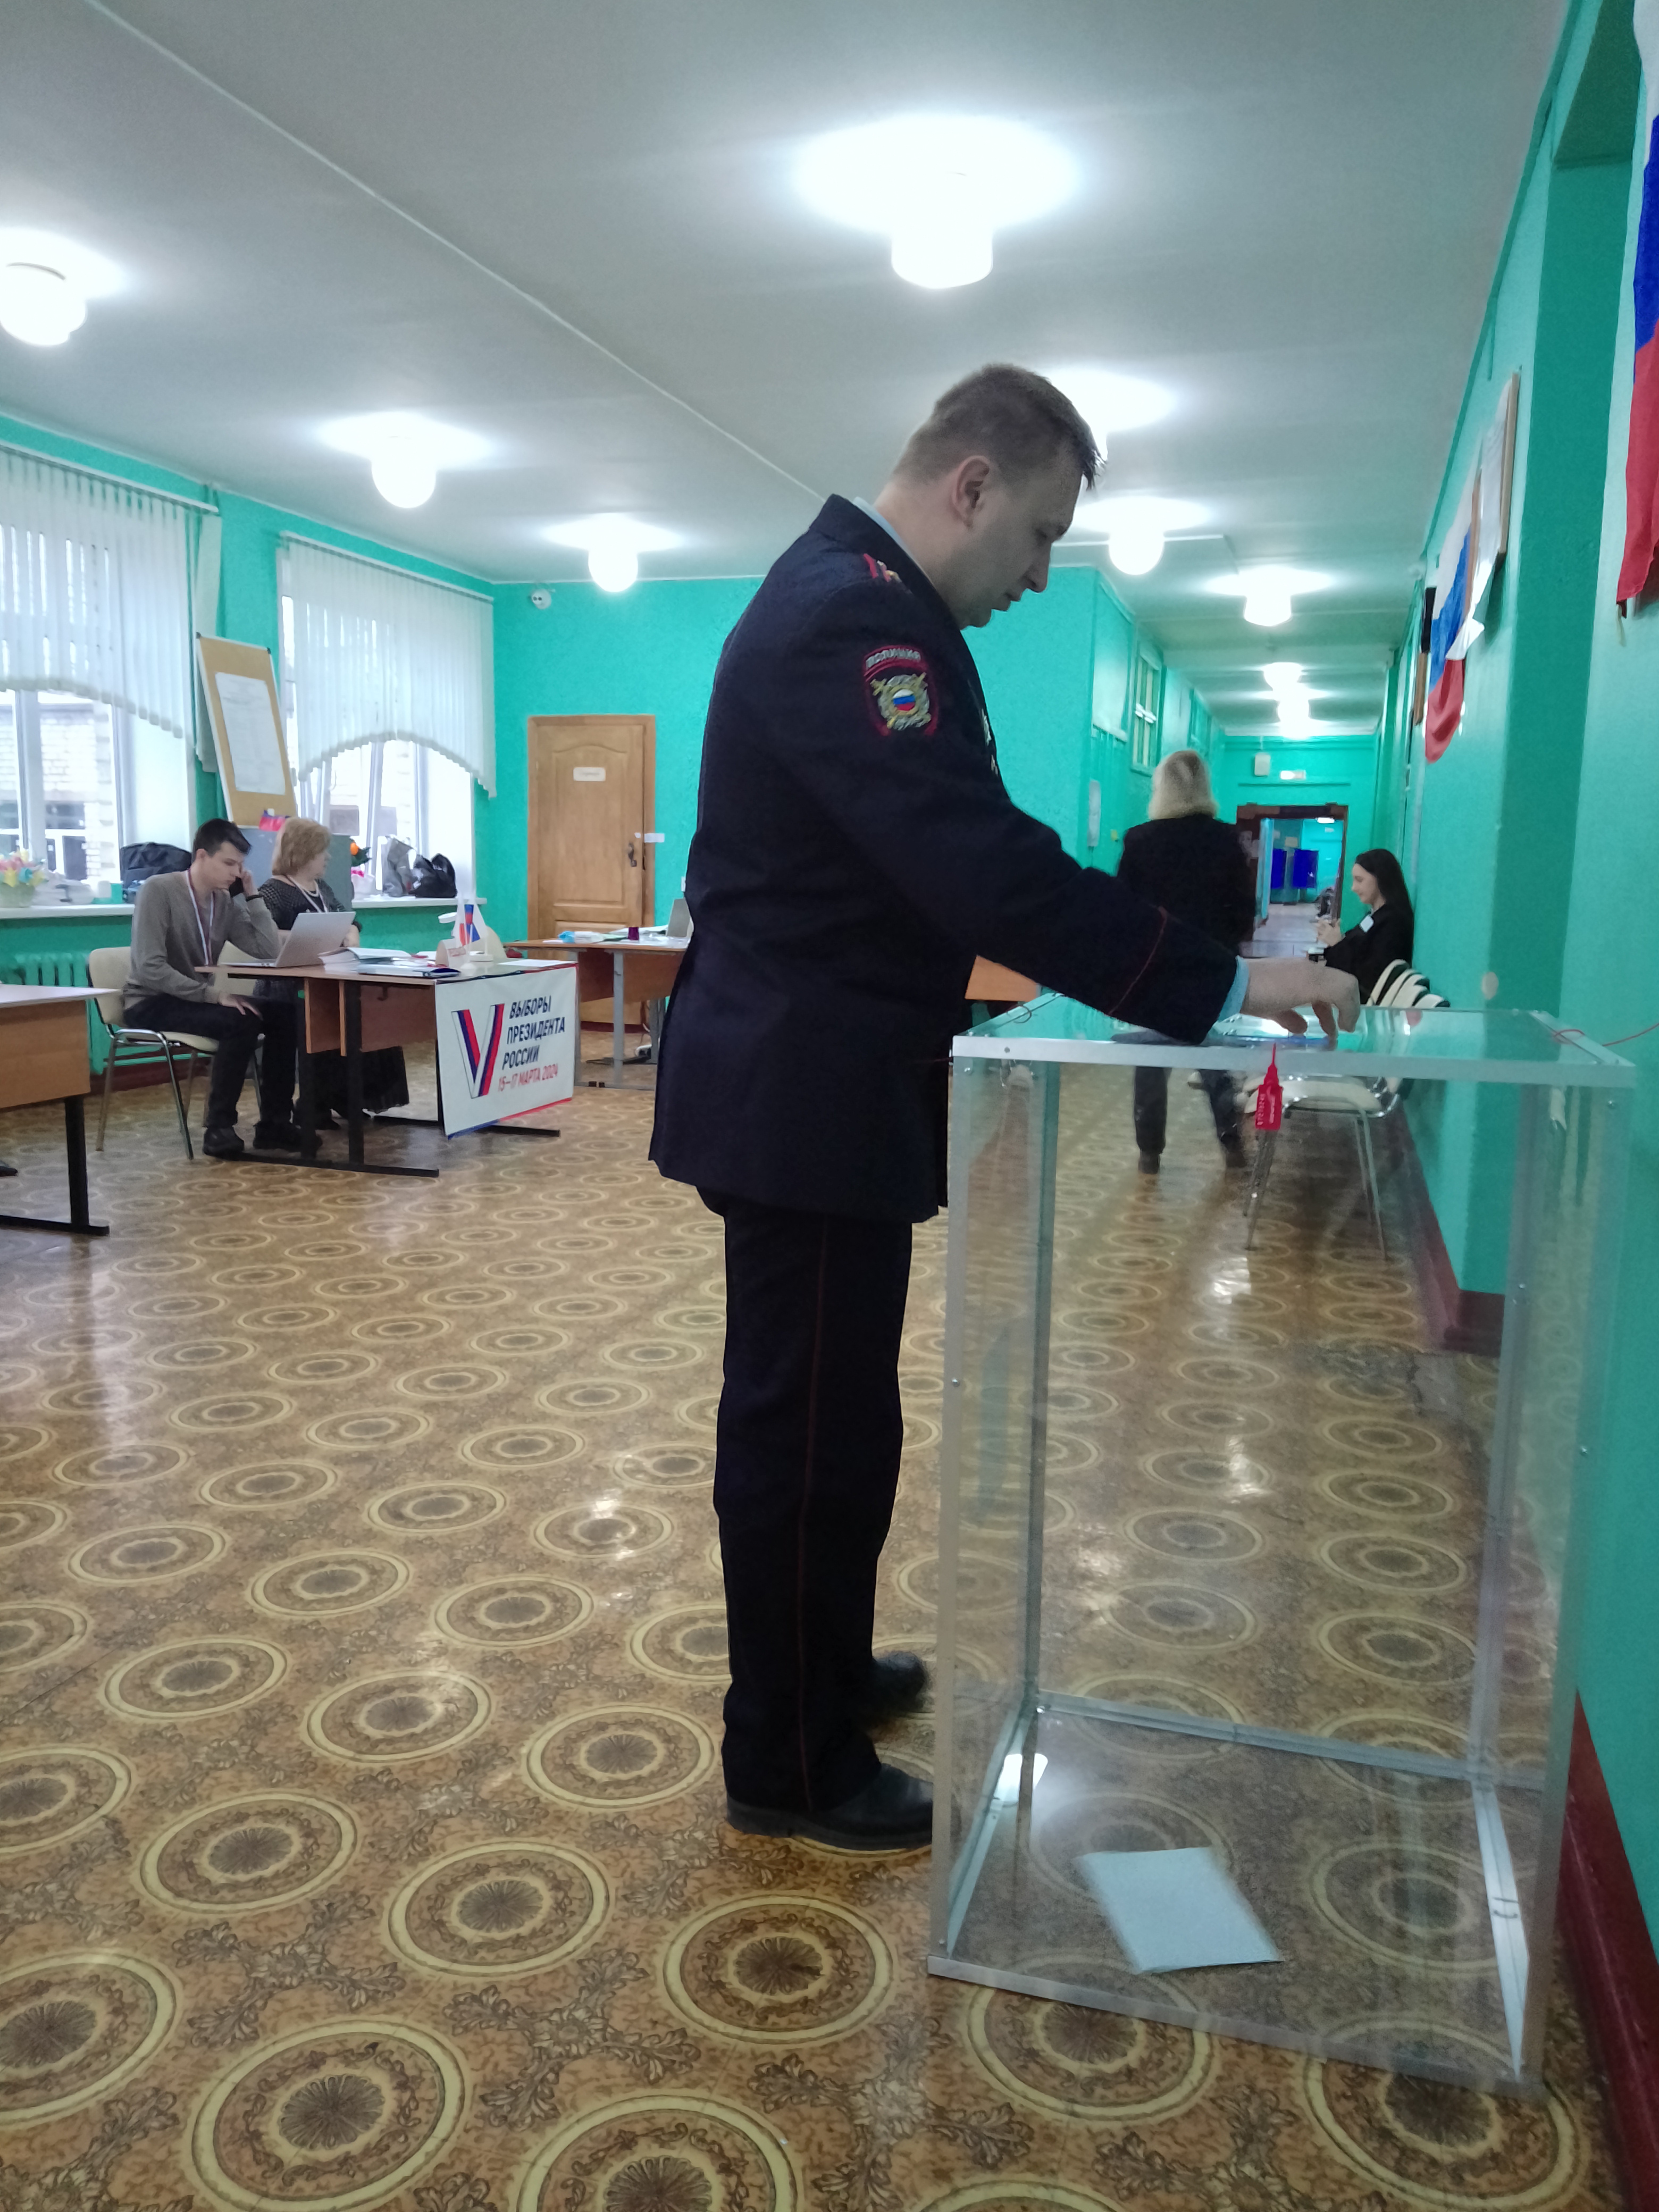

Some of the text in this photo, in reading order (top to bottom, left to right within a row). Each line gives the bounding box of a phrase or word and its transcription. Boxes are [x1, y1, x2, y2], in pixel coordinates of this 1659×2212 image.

[509, 995, 551, 1019] ВЫБОРЫ
[507, 1017, 565, 1044] ПРЕЗИДЕНТА
[502, 1045, 540, 1070] РОССИИ
[518, 1067, 540, 1086] МАРТА
[542, 1063, 558, 1080] 2024
